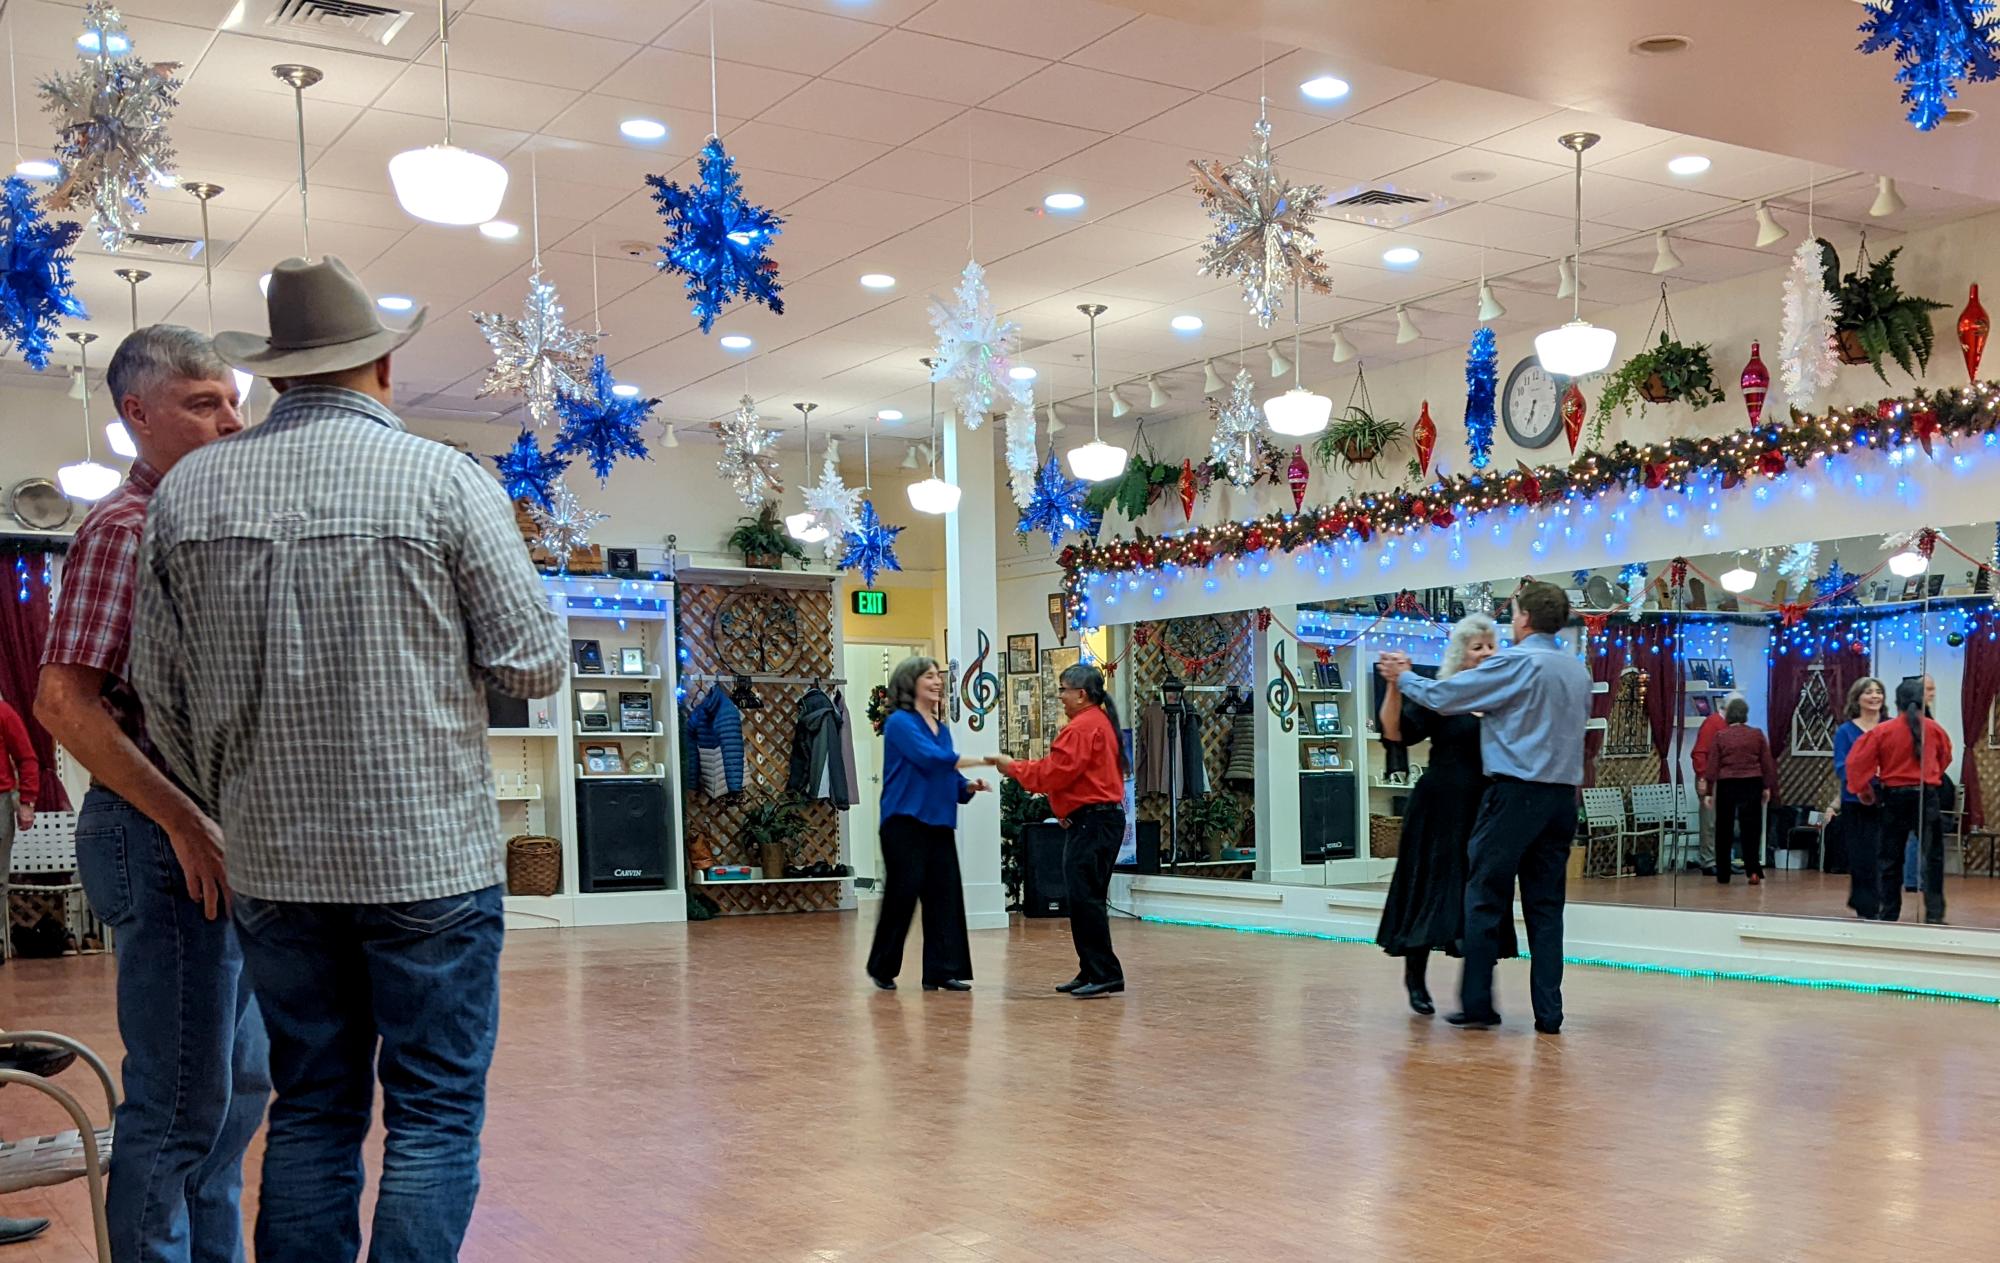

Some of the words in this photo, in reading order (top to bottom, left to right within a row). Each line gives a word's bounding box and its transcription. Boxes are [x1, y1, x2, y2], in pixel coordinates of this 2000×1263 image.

[1523, 375, 1531, 386] 11
[1517, 386, 1525, 397] 10
[858, 591, 884, 614] EXIT
